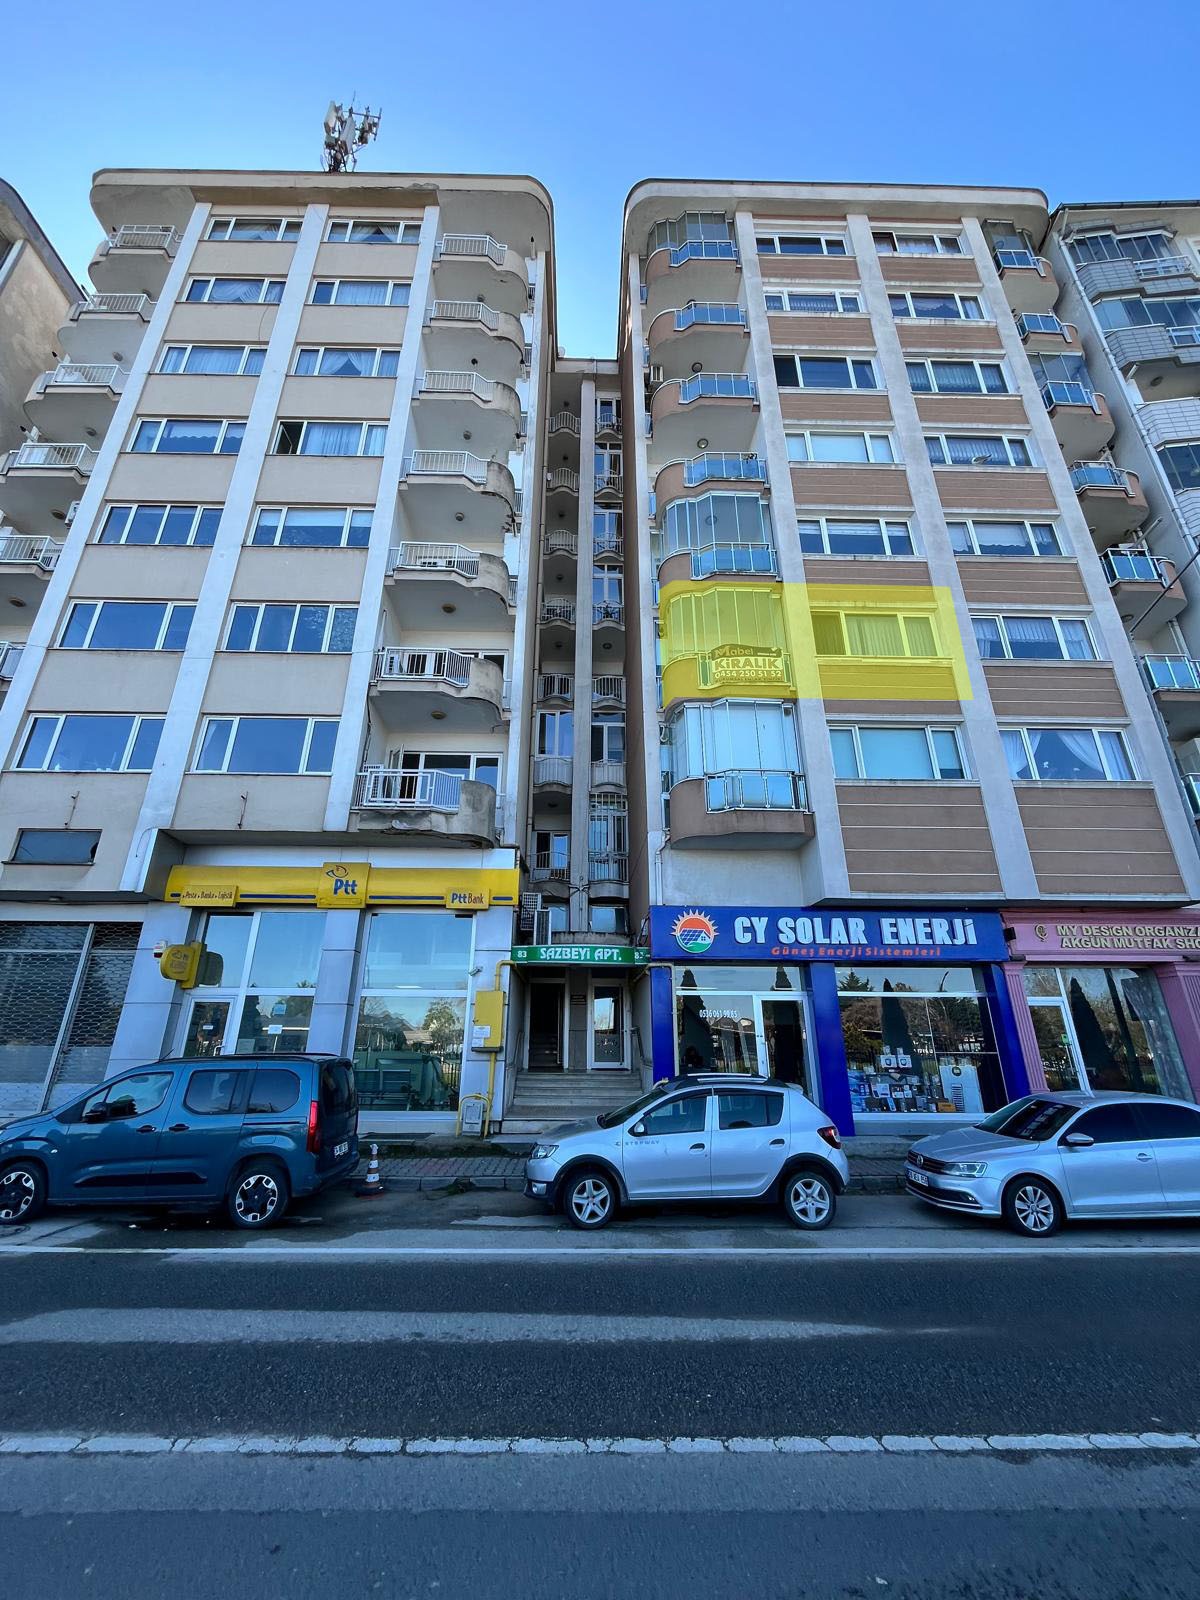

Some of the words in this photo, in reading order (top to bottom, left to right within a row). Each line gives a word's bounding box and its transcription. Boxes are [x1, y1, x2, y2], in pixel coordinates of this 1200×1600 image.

[715, 646, 754, 657] Mabel
[714, 670, 737, 678] 0454
[333, 878, 358, 896] Ptt
[734, 916, 769, 944] CY
[777, 917, 868, 945] SOLAR
[1057, 925, 1078, 937] MY
[1061, 936, 1113, 949] AKGÜN
[1114, 937, 1172, 949] MUTFAK
[517, 950, 527, 958] 83
[594, 948, 622, 961] APT.
[771, 946, 815, 957] Güneş
[818, 946, 863, 957] Enerji
[865, 946, 941, 956] Sistemleri
